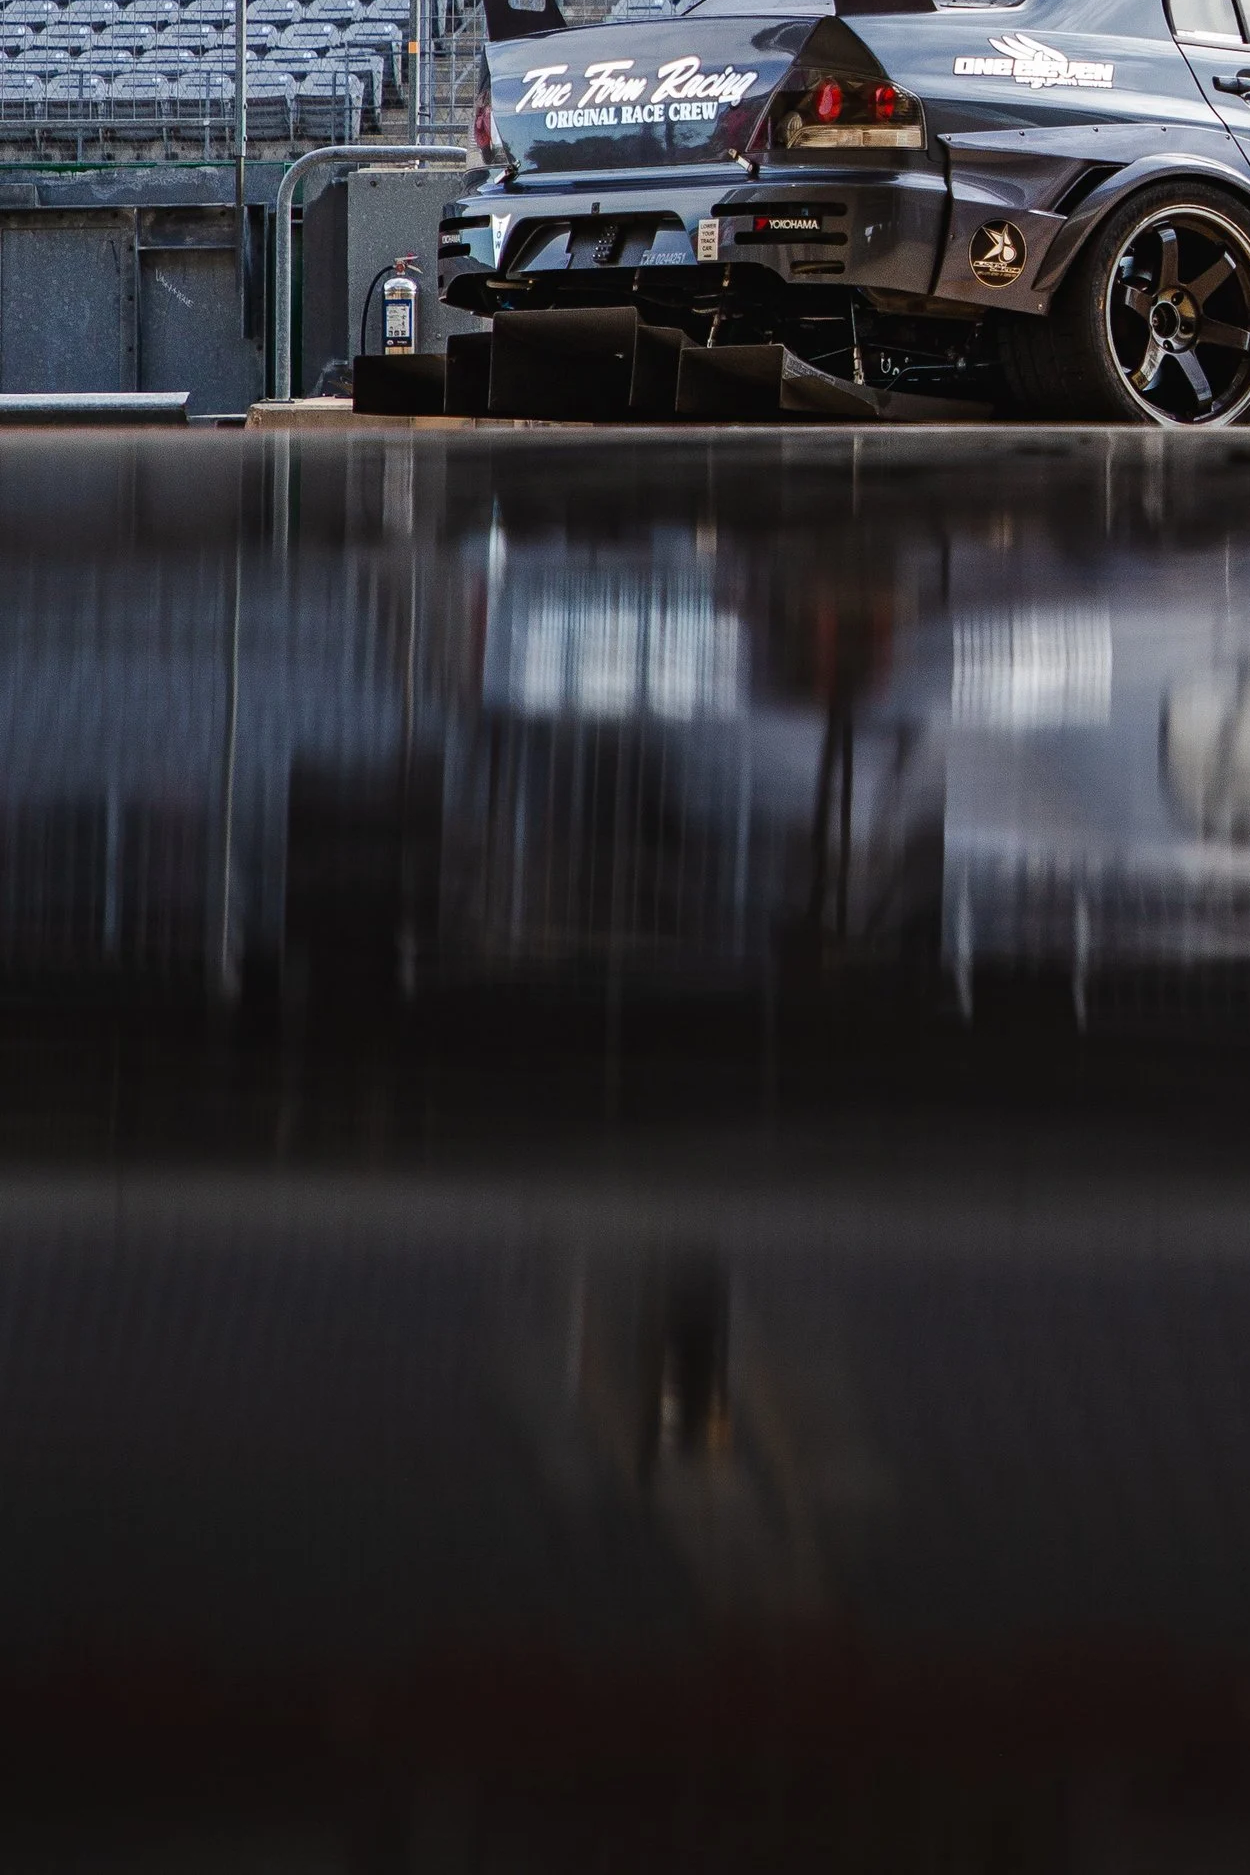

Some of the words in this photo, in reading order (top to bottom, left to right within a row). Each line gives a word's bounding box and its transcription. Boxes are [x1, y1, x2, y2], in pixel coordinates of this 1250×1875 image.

[516, 64, 573, 112] True
[578, 59, 648, 108] Form
[651, 55, 758, 106] Racing
[545, 109, 618, 129] ORIGINAL
[621, 104, 664, 124] RACE
[668, 101, 718, 121] CREW
[769, 219, 819, 229] YOKOHAMA
